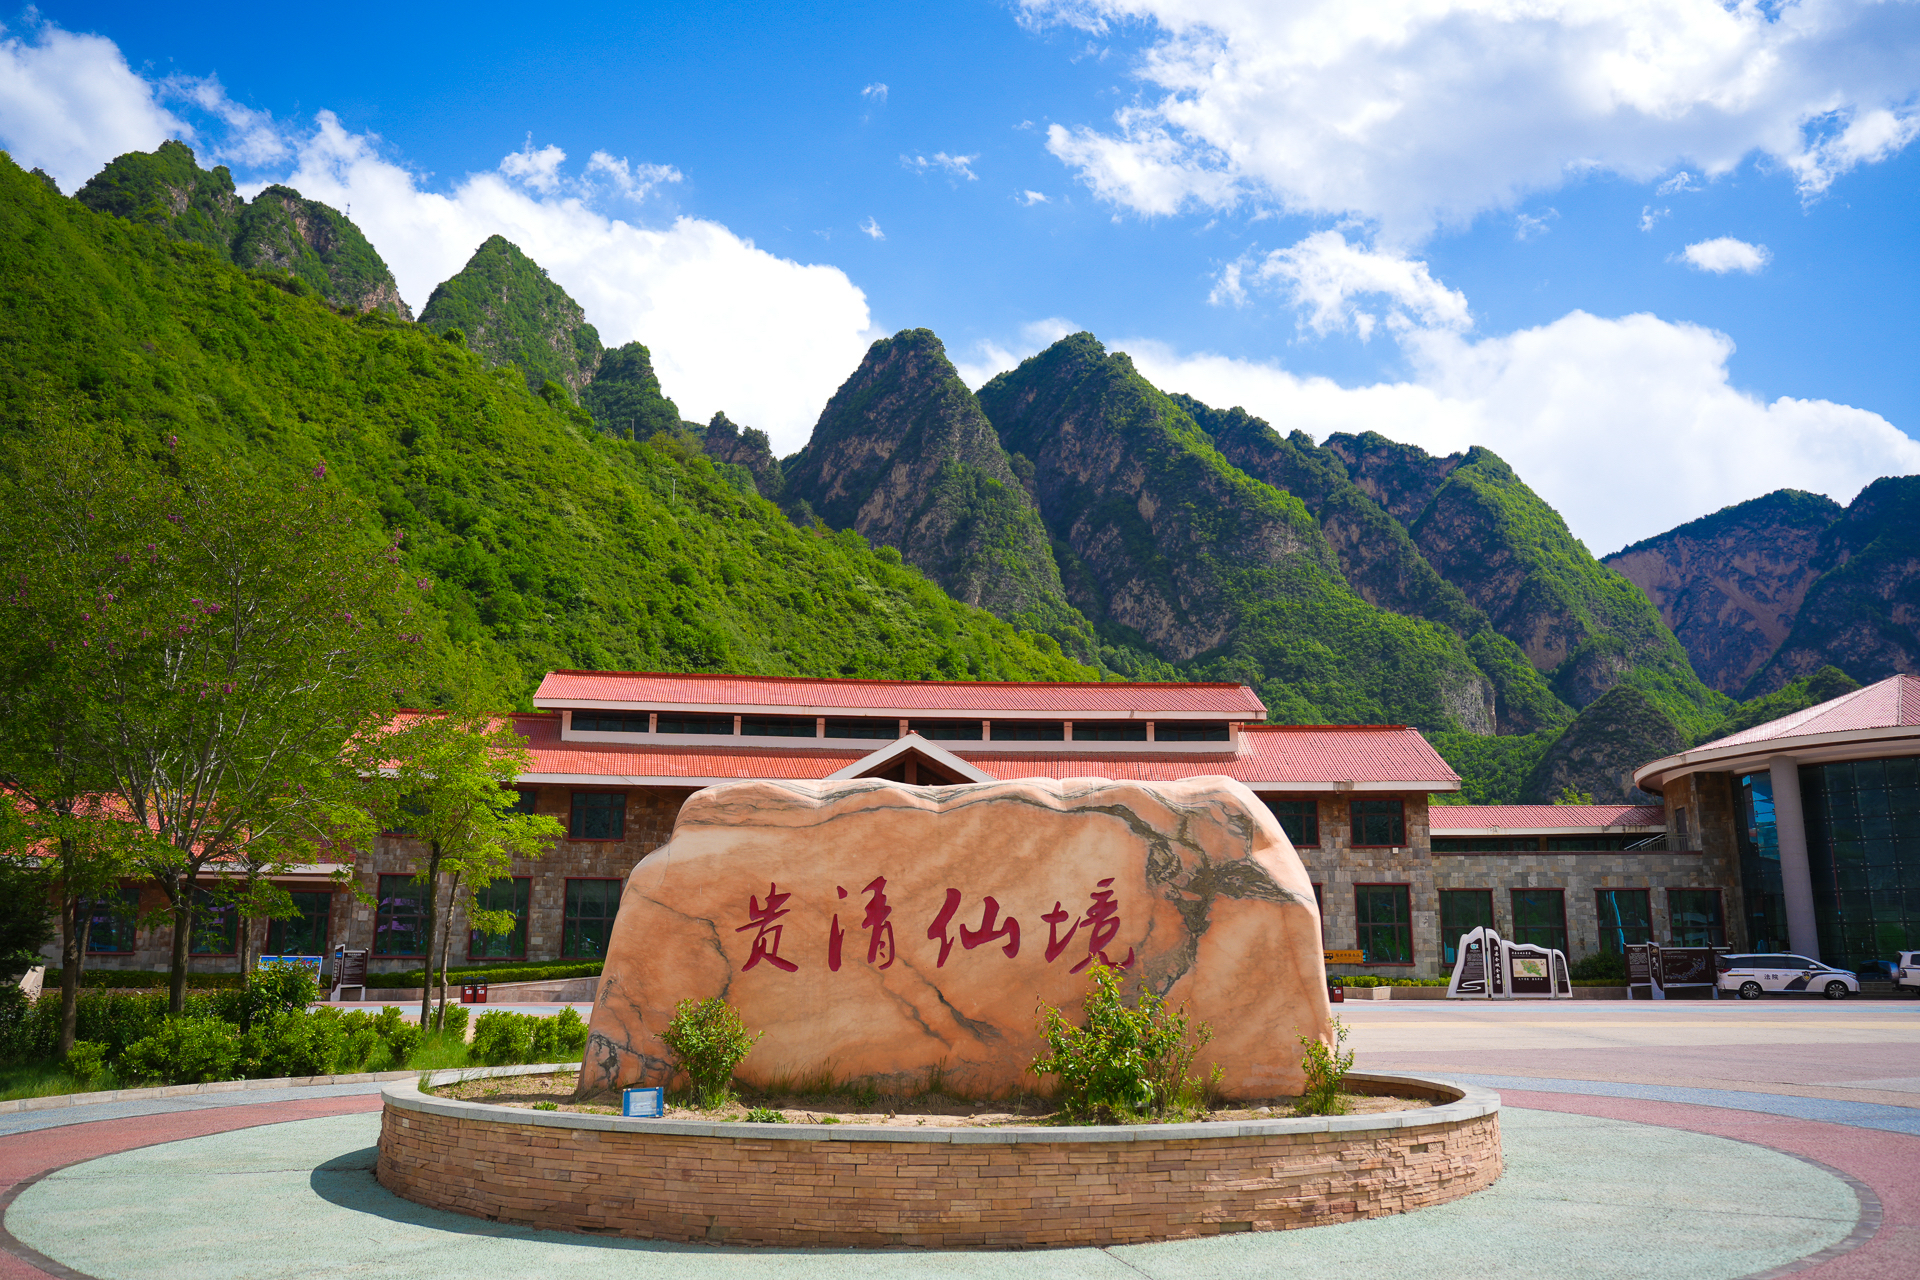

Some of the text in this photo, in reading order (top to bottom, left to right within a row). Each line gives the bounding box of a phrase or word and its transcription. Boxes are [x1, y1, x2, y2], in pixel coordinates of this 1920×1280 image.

[735, 875, 1136, 975] 贵清仙境
[1763, 973, 1779, 981] 法院
